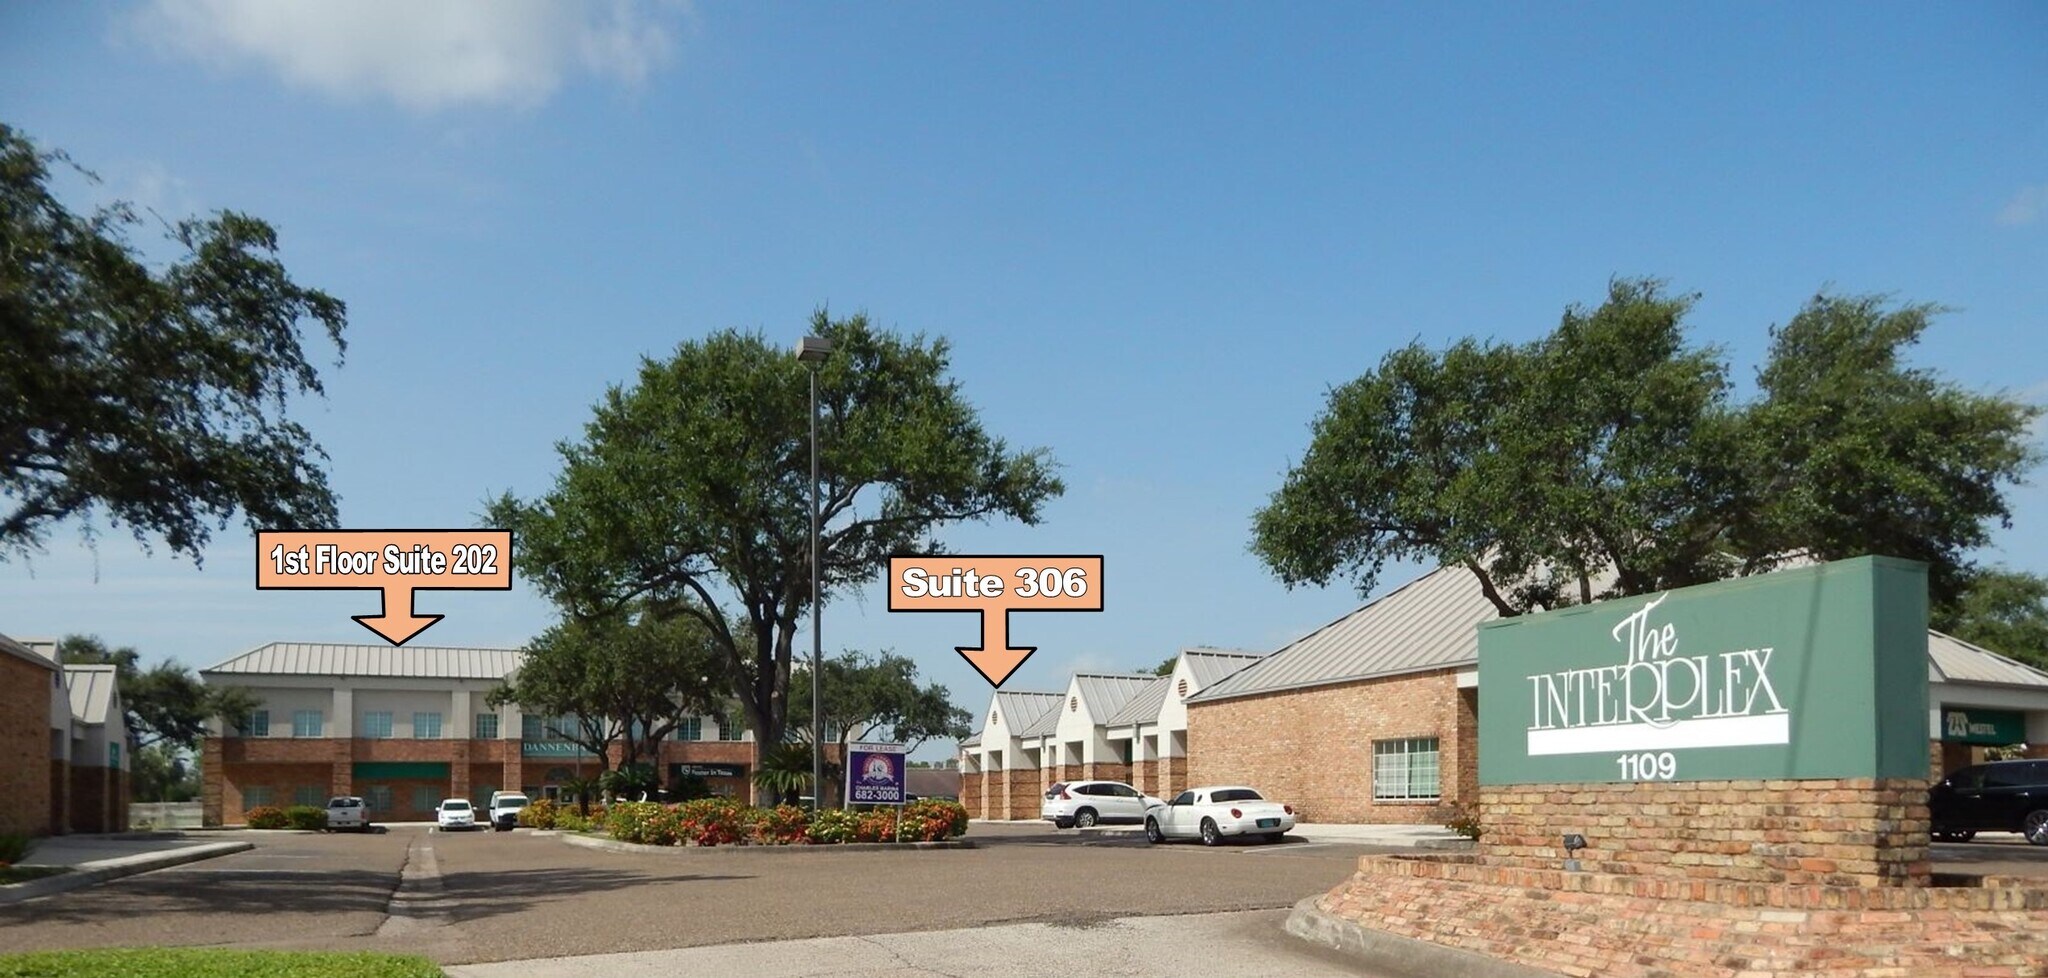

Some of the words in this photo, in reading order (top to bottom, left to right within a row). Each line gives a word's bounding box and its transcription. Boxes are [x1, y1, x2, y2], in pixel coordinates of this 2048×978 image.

[1612, 591, 1679, 681] The
[1526, 648, 1789, 730] INTERPLEX
[1616, 752, 1677, 780] 1109
